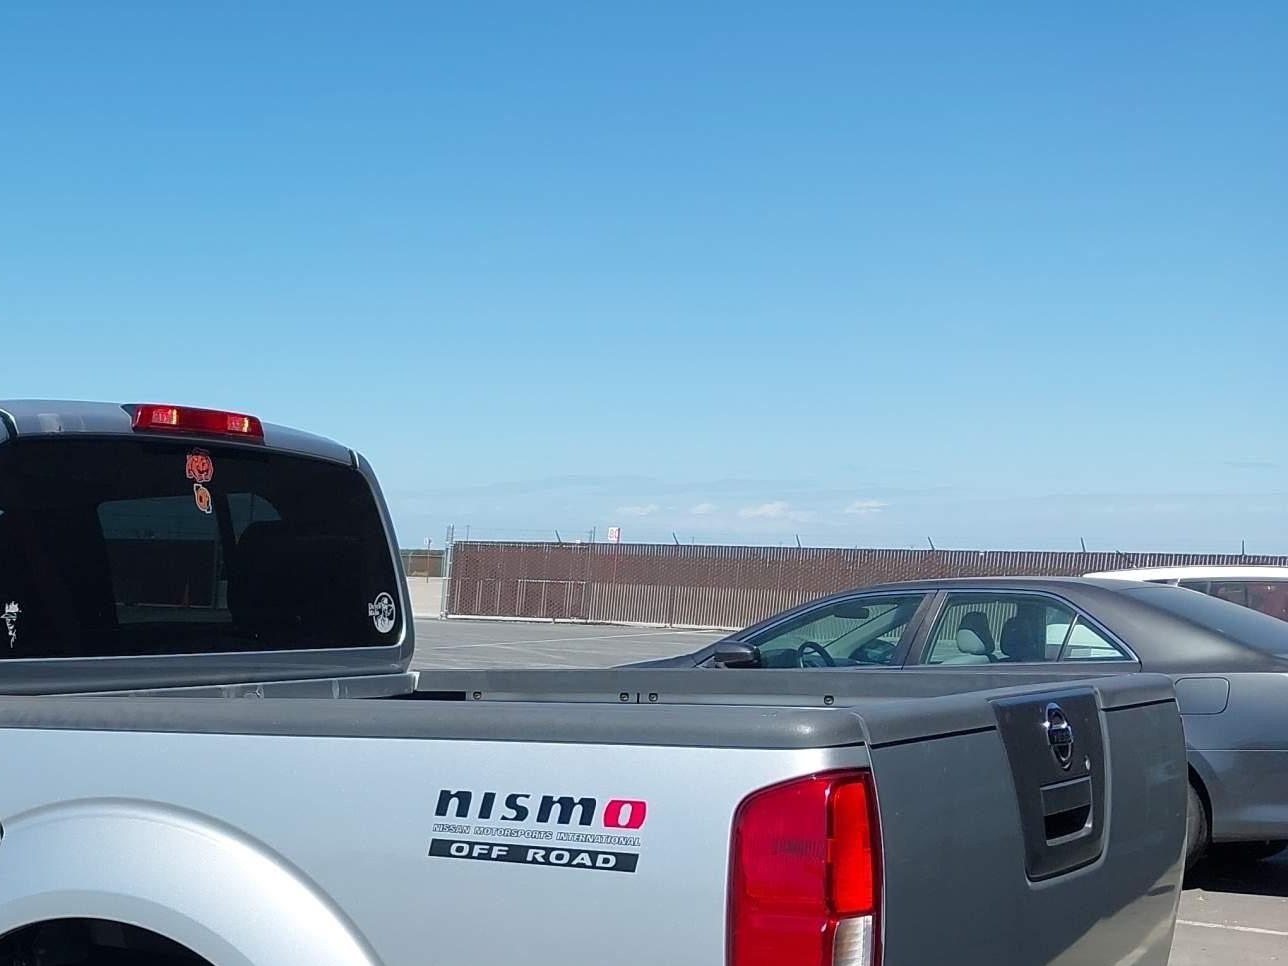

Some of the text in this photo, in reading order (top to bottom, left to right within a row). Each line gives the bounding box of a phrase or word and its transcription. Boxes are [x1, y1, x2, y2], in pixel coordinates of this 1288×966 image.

[434, 789, 648, 830] nismo
[432, 823, 642, 847] NISSAN MOTORSPORTS INTERNATIONAL
[450, 842, 617, 868] OFF ROAD
